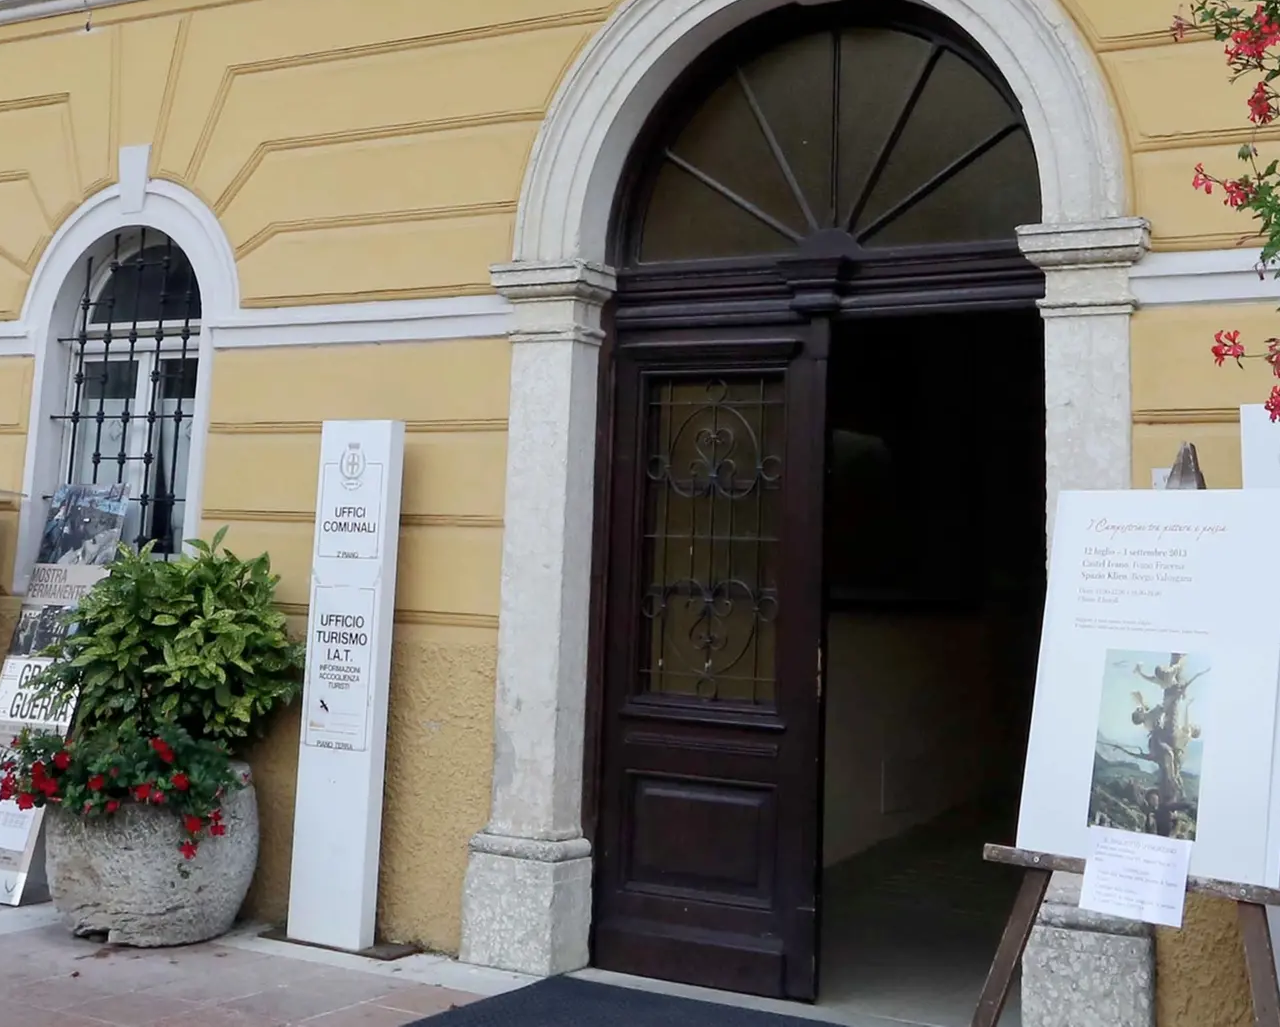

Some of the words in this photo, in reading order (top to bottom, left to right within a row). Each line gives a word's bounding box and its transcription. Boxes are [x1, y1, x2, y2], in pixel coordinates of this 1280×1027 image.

[334, 506, 366, 518] UFFICI
[323, 520, 376, 533] COMUNALI
[1129, 549, 1167, 557] settembre
[30, 567, 68, 583] MOSTRA
[27, 583, 87, 600] PERMANENTE
[320, 614, 365, 628] UFFICIO
[316, 630, 368, 646] TURISMO
[326, 648, 354, 662] I.A.T.
[319, 664, 361, 674] INFORMAZIONI
[319, 673, 360, 682] ACCOGLIENZA
[328, 681, 350, 690] TURISTI
